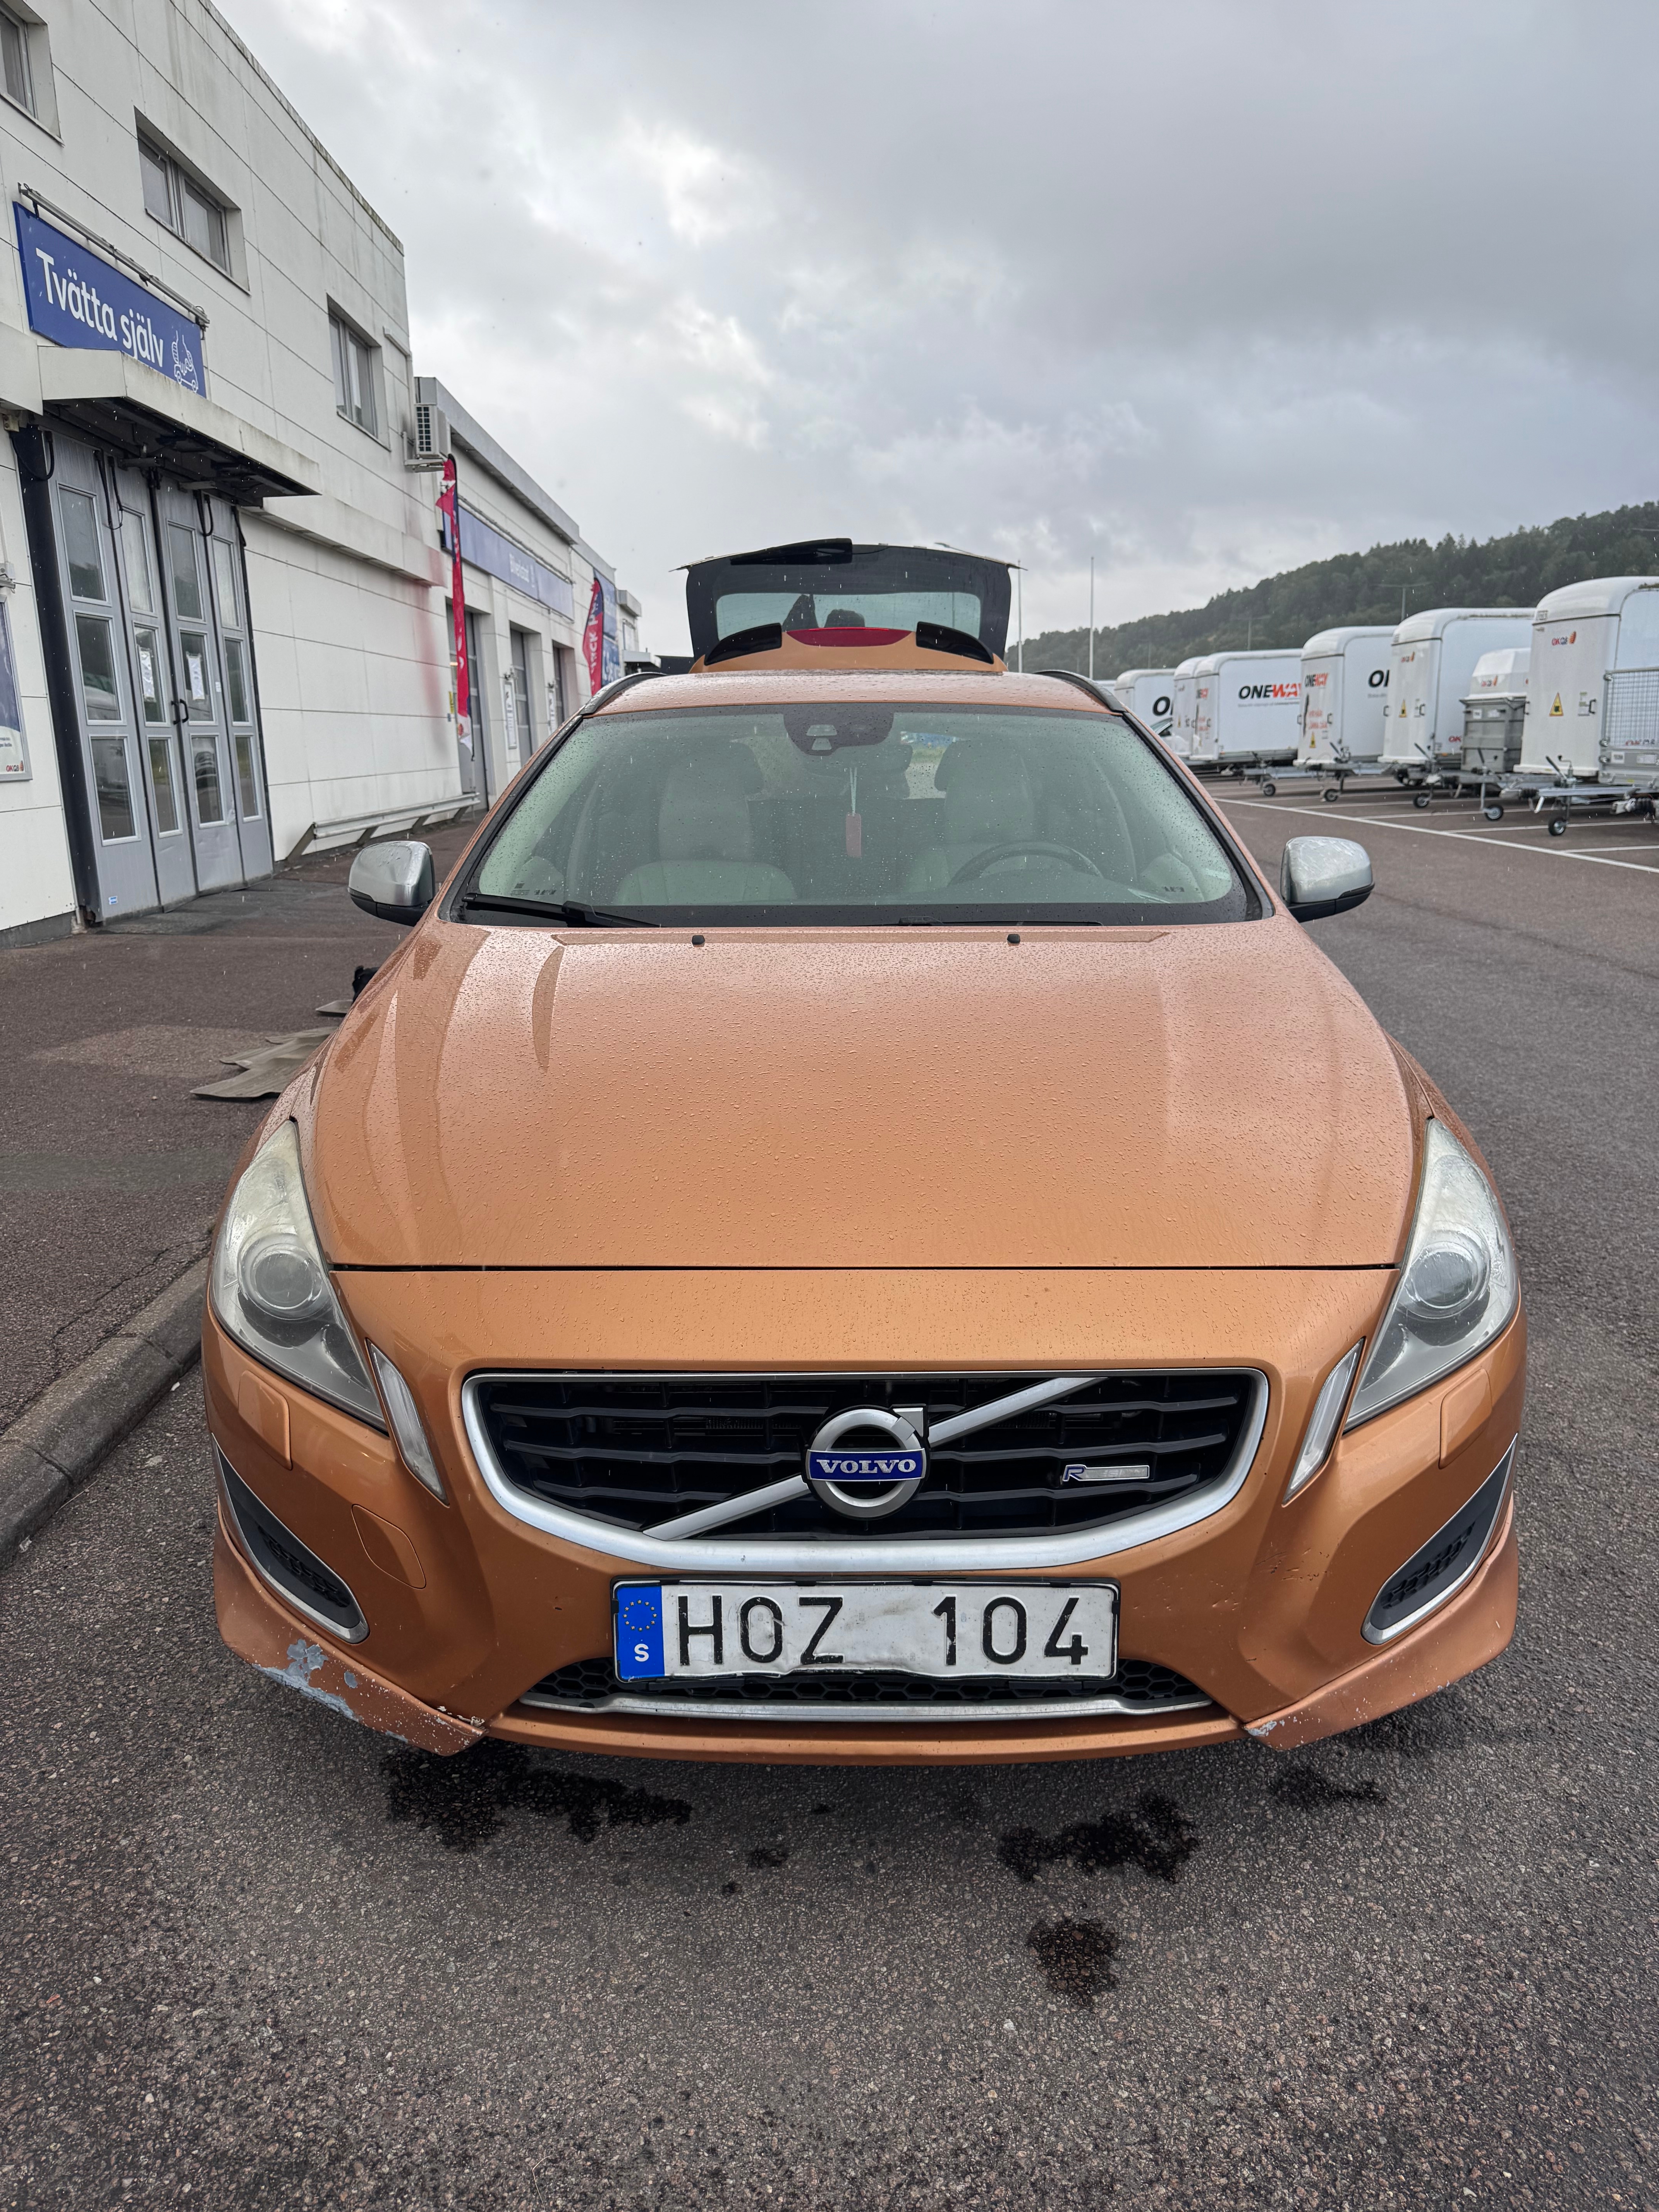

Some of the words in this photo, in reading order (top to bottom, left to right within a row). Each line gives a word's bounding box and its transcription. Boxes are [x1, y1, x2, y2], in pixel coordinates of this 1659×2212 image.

[36, 247, 117, 341] Tvätta
[120, 309, 163, 367] själv
[1153, 696, 1173, 716] O
[816, 1459, 916, 1473] VOLVO
[678, 1595, 843, 1665] HOZ
[933, 1596, 1089, 1665] 104
[634, 1644, 649, 1662] S
